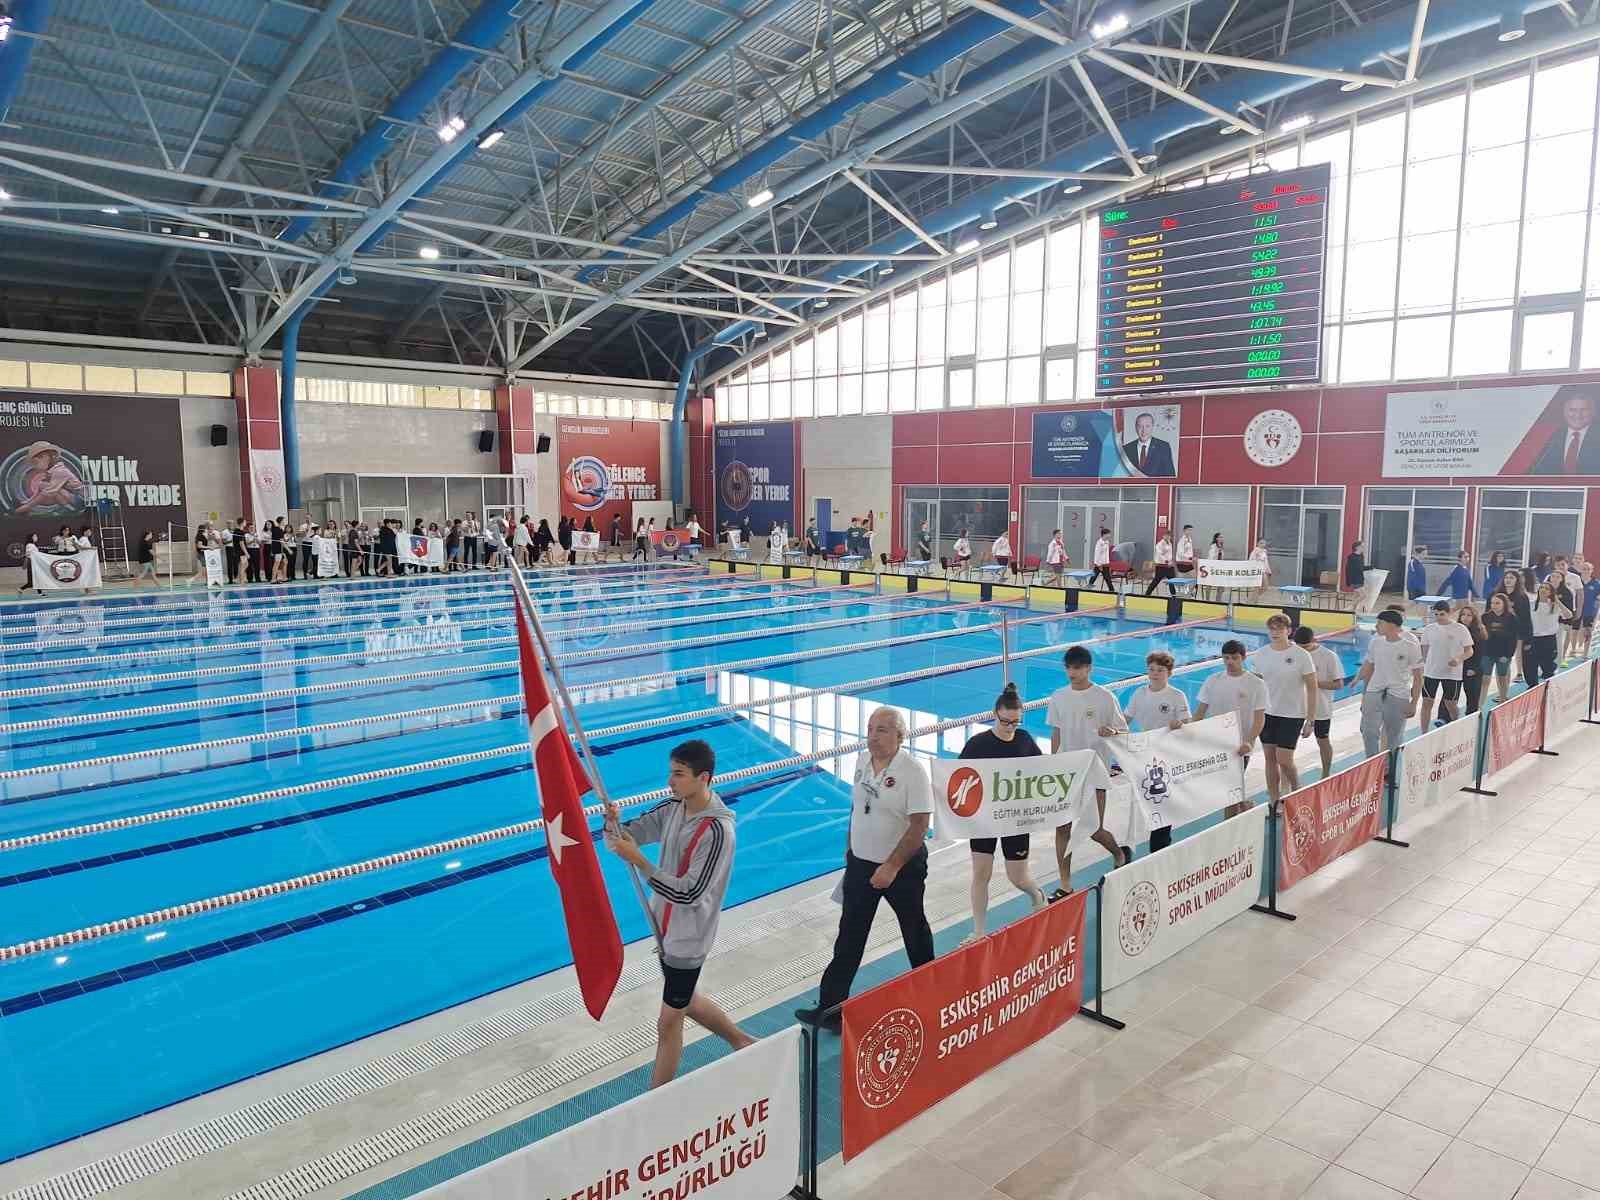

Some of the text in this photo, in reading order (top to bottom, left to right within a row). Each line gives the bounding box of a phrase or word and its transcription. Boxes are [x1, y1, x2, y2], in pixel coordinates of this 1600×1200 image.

[0, 401, 16, 415] ENÇ
[80, 455, 139, 482] İYİLİK
[124, 484, 182, 507] YERDE
[764, 485, 790, 501] YERDE
[991, 769, 1077, 803] birey
[1168, 864, 1211, 899] ESKİŞEHİR
[1169, 899, 1193, 926] SPOR
[1194, 891, 1203, 912] İL
[940, 935, 1077, 1029] ESKİŞEHİR GENÇLİK VE
[937, 1023, 979, 1059] SPOR
[982, 1012, 995, 1036] İL
[998, 959, 1075, 1027] MÜDÜRLÜĞÜ
[637, 1112, 737, 1182] GENÇLİK
[741, 1097, 769, 1129] VE
